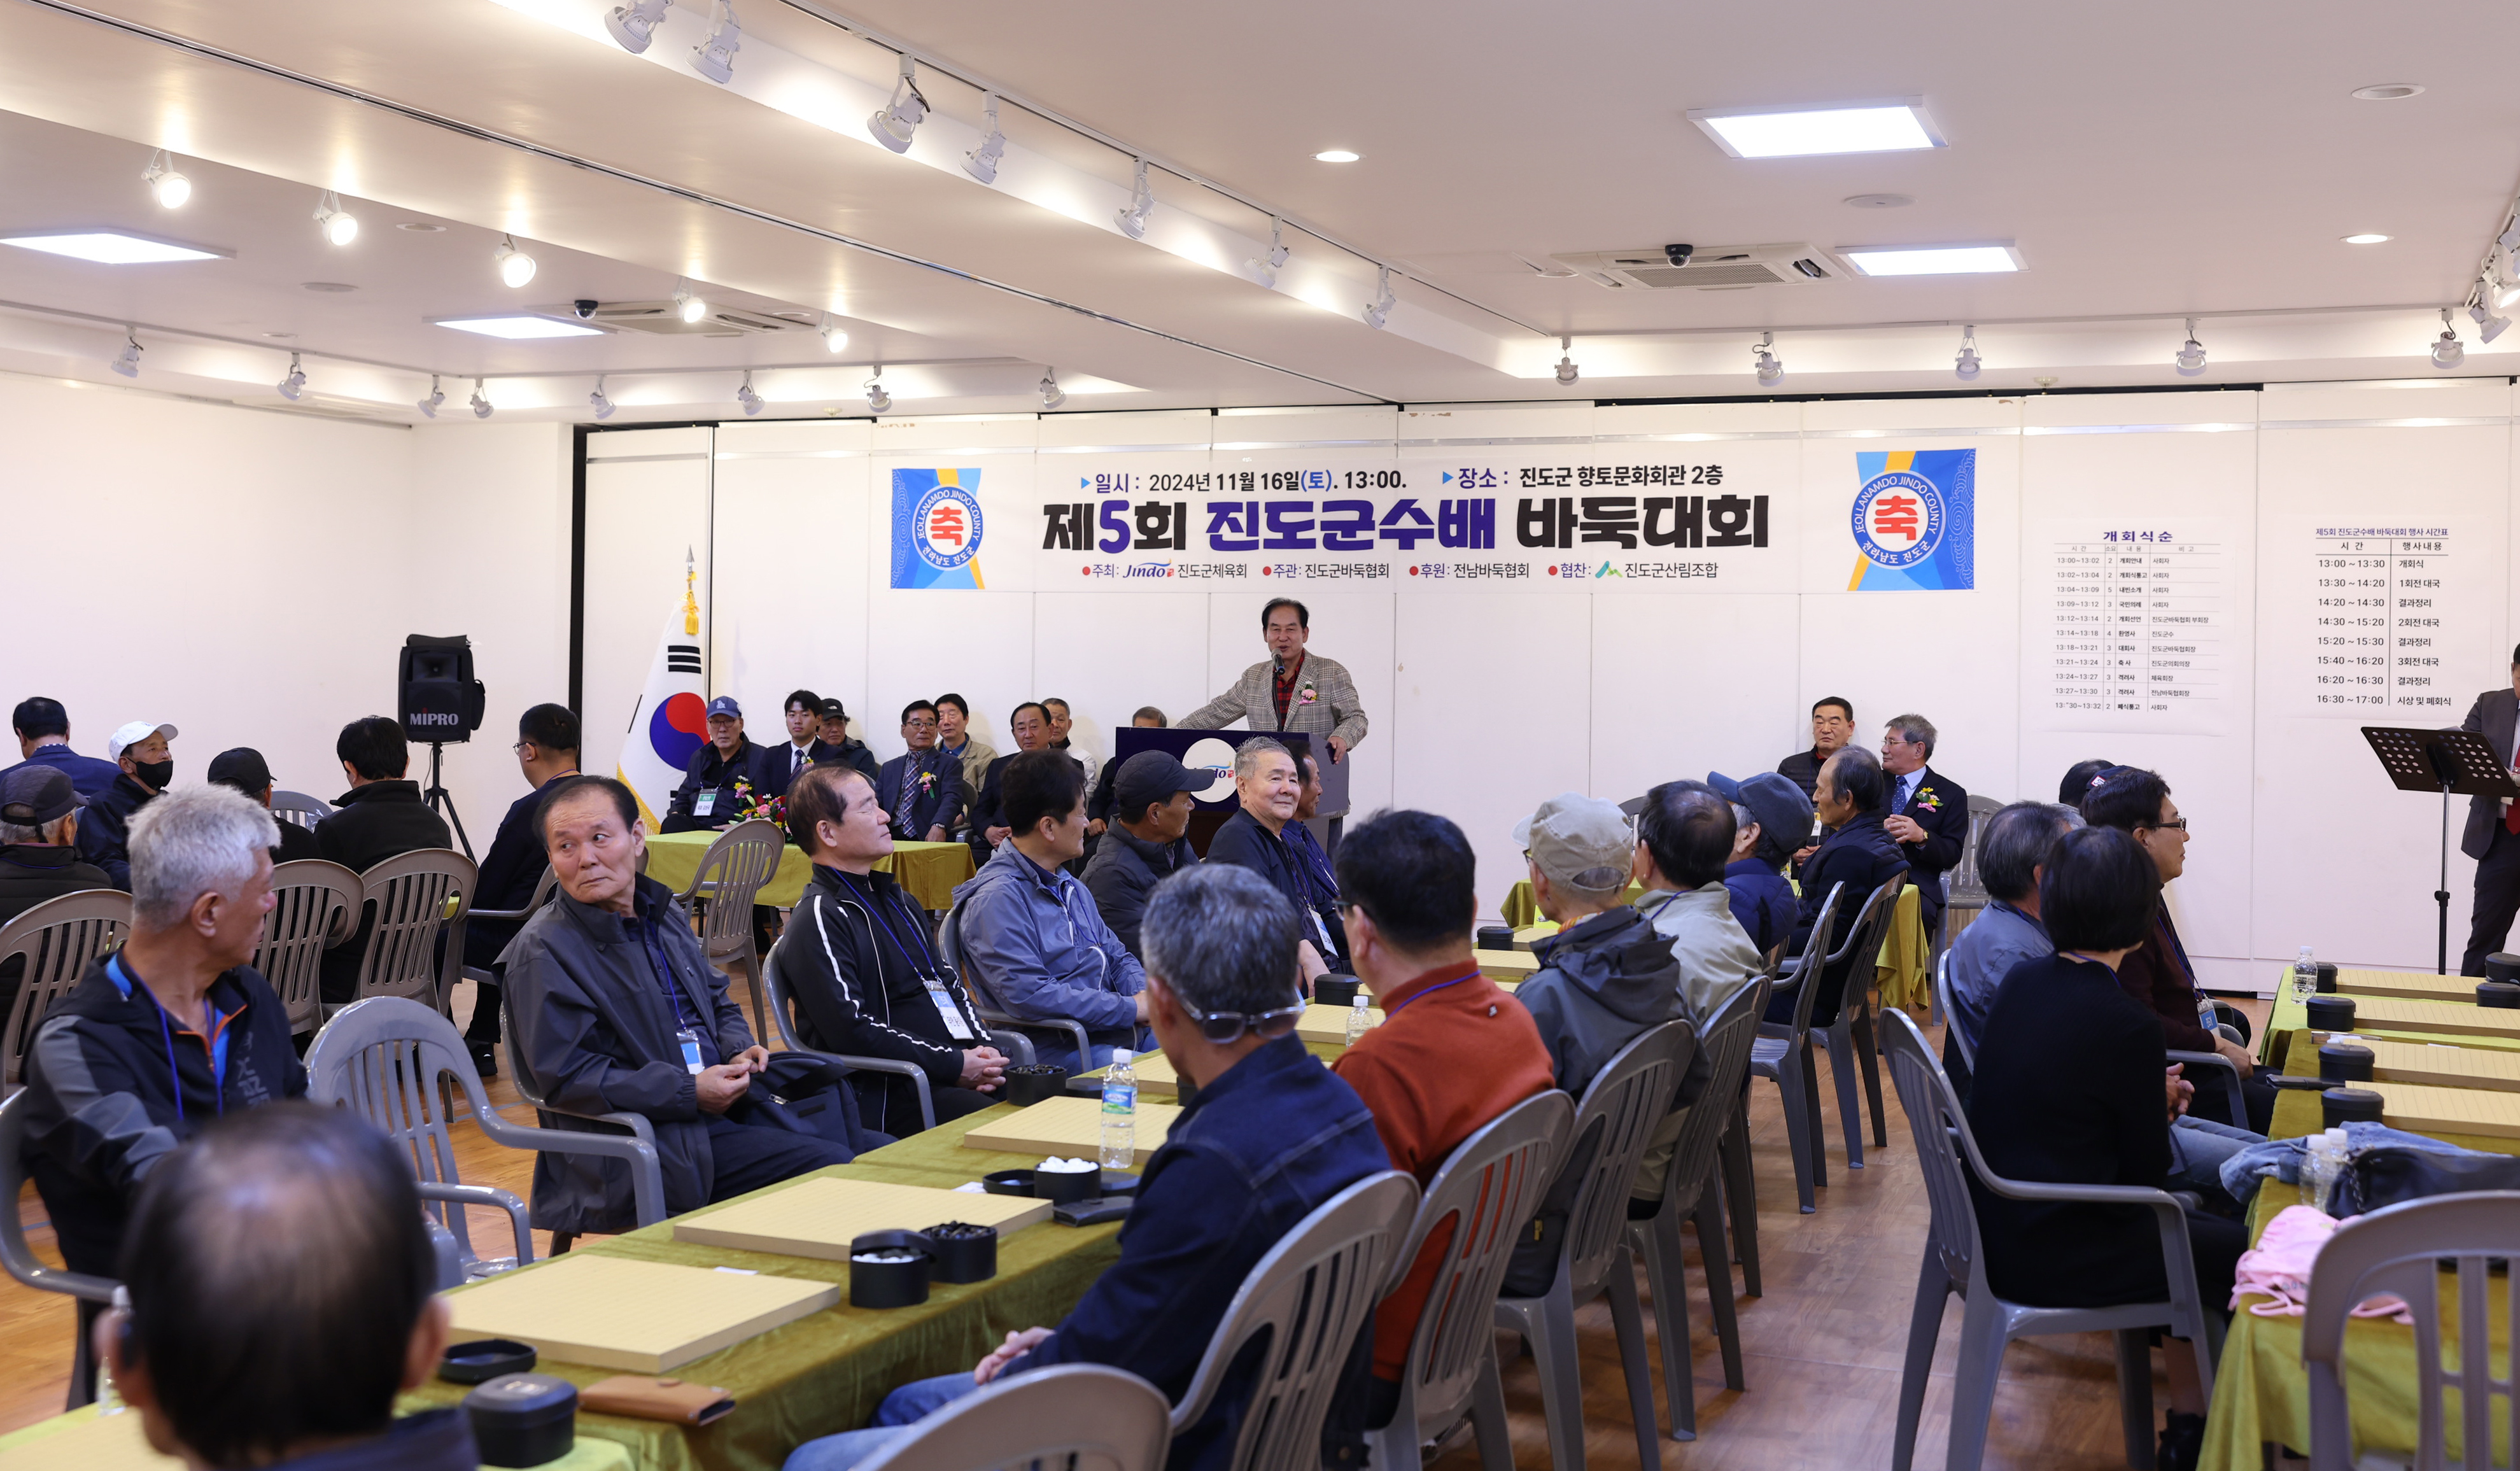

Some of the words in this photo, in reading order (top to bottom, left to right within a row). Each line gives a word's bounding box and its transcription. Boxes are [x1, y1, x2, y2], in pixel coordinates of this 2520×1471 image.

[1096, 473, 1129, 493] 일시
[1149, 472, 1210, 492] 2024년
[1216, 471, 1255, 492] 11월
[1344, 470, 1407, 489] 13:00.
[1458, 467, 1497, 489] 장소
[1519, 467, 1573, 488] 진도군
[1577, 464, 1687, 488] 향토문화회관
[1691, 464, 1724, 486] 2층
[1854, 476, 1897, 534] JEOLLANAMDO
[1898, 476, 1928, 495] JINDO
[1924, 492, 1940, 535] COUNTY
[917, 490, 950, 539] JEOLLANAMDO
[950, 489, 973, 507] JINDO
[969, 504, 981, 540] COUNTY
[1874, 495, 1918, 540] 축
[931, 507, 964, 545] 축
[1042, 499, 1187, 554] 제5회
[1205, 498, 1496, 552] 진도군수배
[1516, 495, 1770, 550] 바둑대회
[922, 545, 950, 566] 전라남도
[953, 546, 975, 565] 진도군
[1862, 540, 1899, 564] 전라남도
[1903, 540, 1931, 563] 진도군
[1092, 564, 1119, 579] 주최:
[1122, 565, 1166, 578] Jindo
[1178, 563, 1247, 579] 진도군체육회
[1273, 563, 1302, 579] 주관:
[1304, 563, 1390, 579] 진도군바둑협회
[1420, 563, 1450, 579] 후원:
[1453, 562, 1530, 579] 전남바둑협회
[1560, 562, 1591, 579] 협찬:
[1625, 562, 1719, 579] 진도군산림조합
[2399, 560, 2423, 568] 개회식
[2400, 579, 2421, 588] 1회전
[2424, 579, 2440, 588] 대국
[2399, 599, 2431, 607] 결과정리
[2398, 619, 2420, 627] 2회전
[2423, 619, 2439, 627] 대국
[2398, 638, 2430, 647] 결과정리
[2398, 658, 2420, 666] 3회전
[2423, 658, 2439, 666] 대국
[2398, 677, 2430, 686] 결과정리
[2398, 696, 2414, 705] 시상
[2416, 697, 2423, 705] 및
[410, 713, 459, 726] MIPRO
